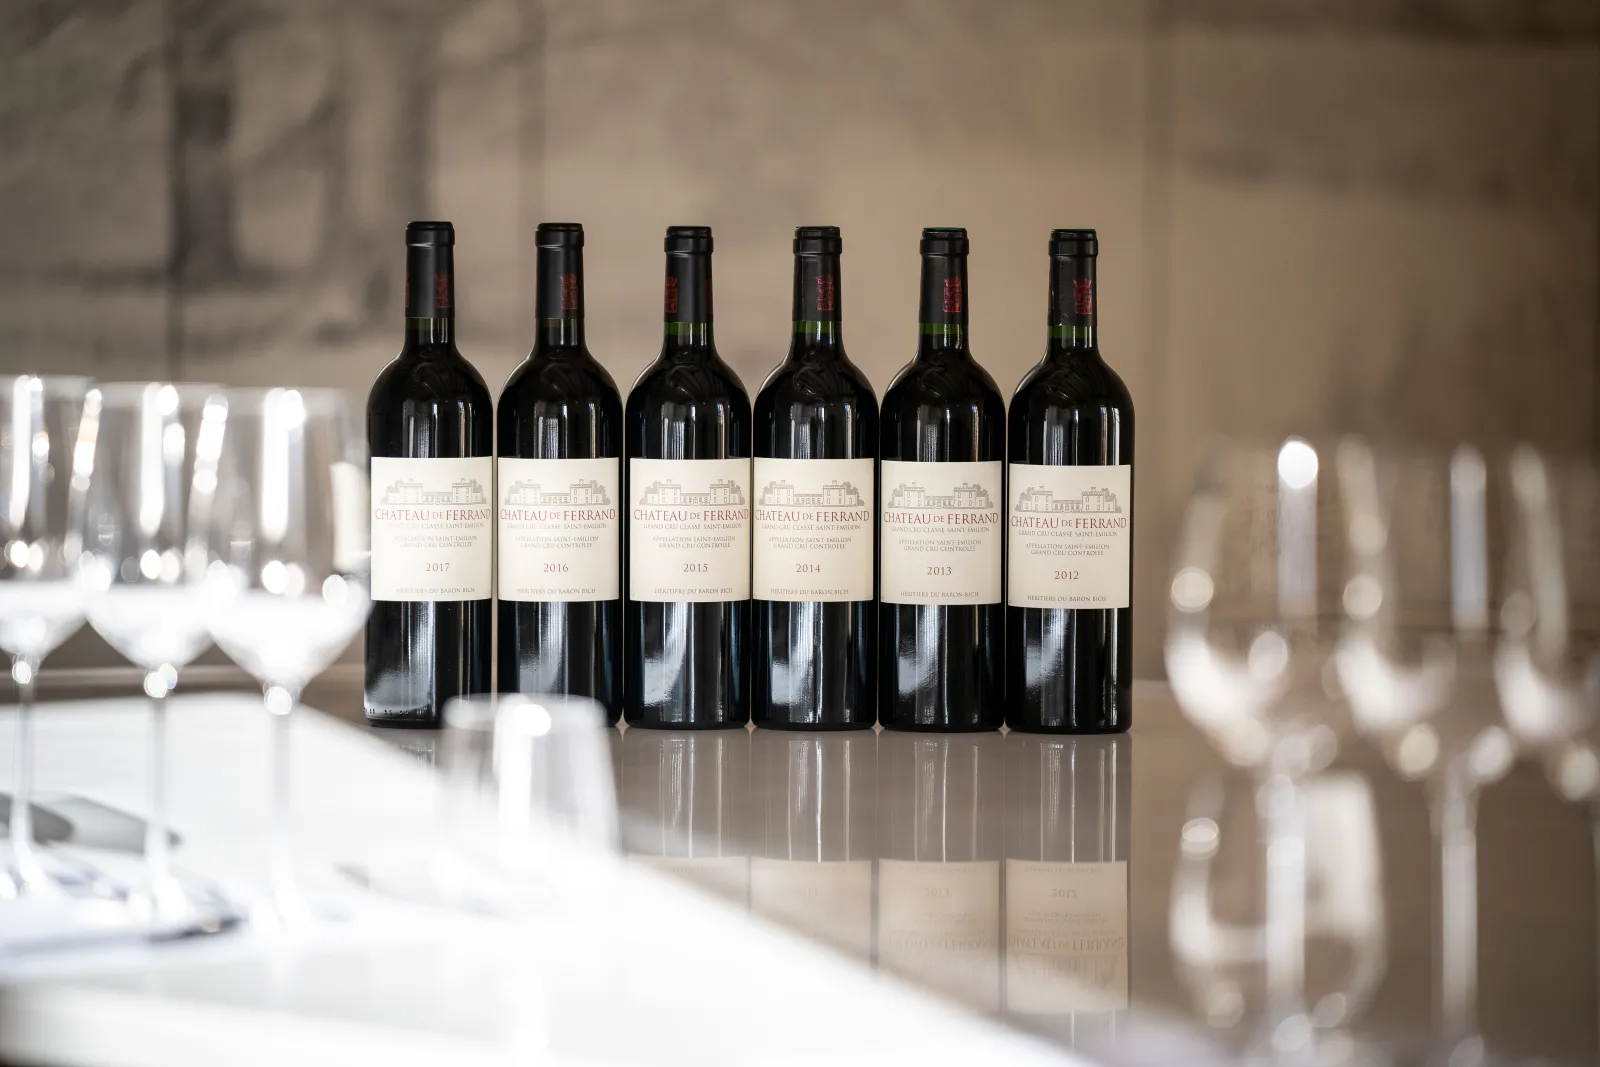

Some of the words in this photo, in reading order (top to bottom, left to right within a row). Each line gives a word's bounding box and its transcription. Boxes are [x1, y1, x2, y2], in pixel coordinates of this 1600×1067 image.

[375, 509, 430, 520] CHATEAU
[446, 509, 491, 520] FERRAND
[500, 508, 547, 521] CHATEAU
[549, 512, 560, 520] DE
[563, 508, 616, 521] FERRAND
[634, 509, 688, 521] CHATEAU
[703, 509, 749, 521] FERRAND
[755, 510, 800, 522] CHATEAU
[816, 510, 870, 522] FERRAND
[883, 512, 931, 524] CHATEAU
[933, 515, 945, 523] DE
[947, 512, 999, 524] FERRAND
[1011, 516, 1059, 528] CHATEAU
[1061, 519, 1073, 527] DE
[1075, 517, 1127, 529] FERRAND
[425, 562, 450, 572] 2017
[543, 563, 569, 573] 2016
[683, 563, 708, 573] 2015
[796, 564, 821, 573] 2014
[927, 566, 952, 576] 2013
[1054, 570, 1080, 580] 2012
